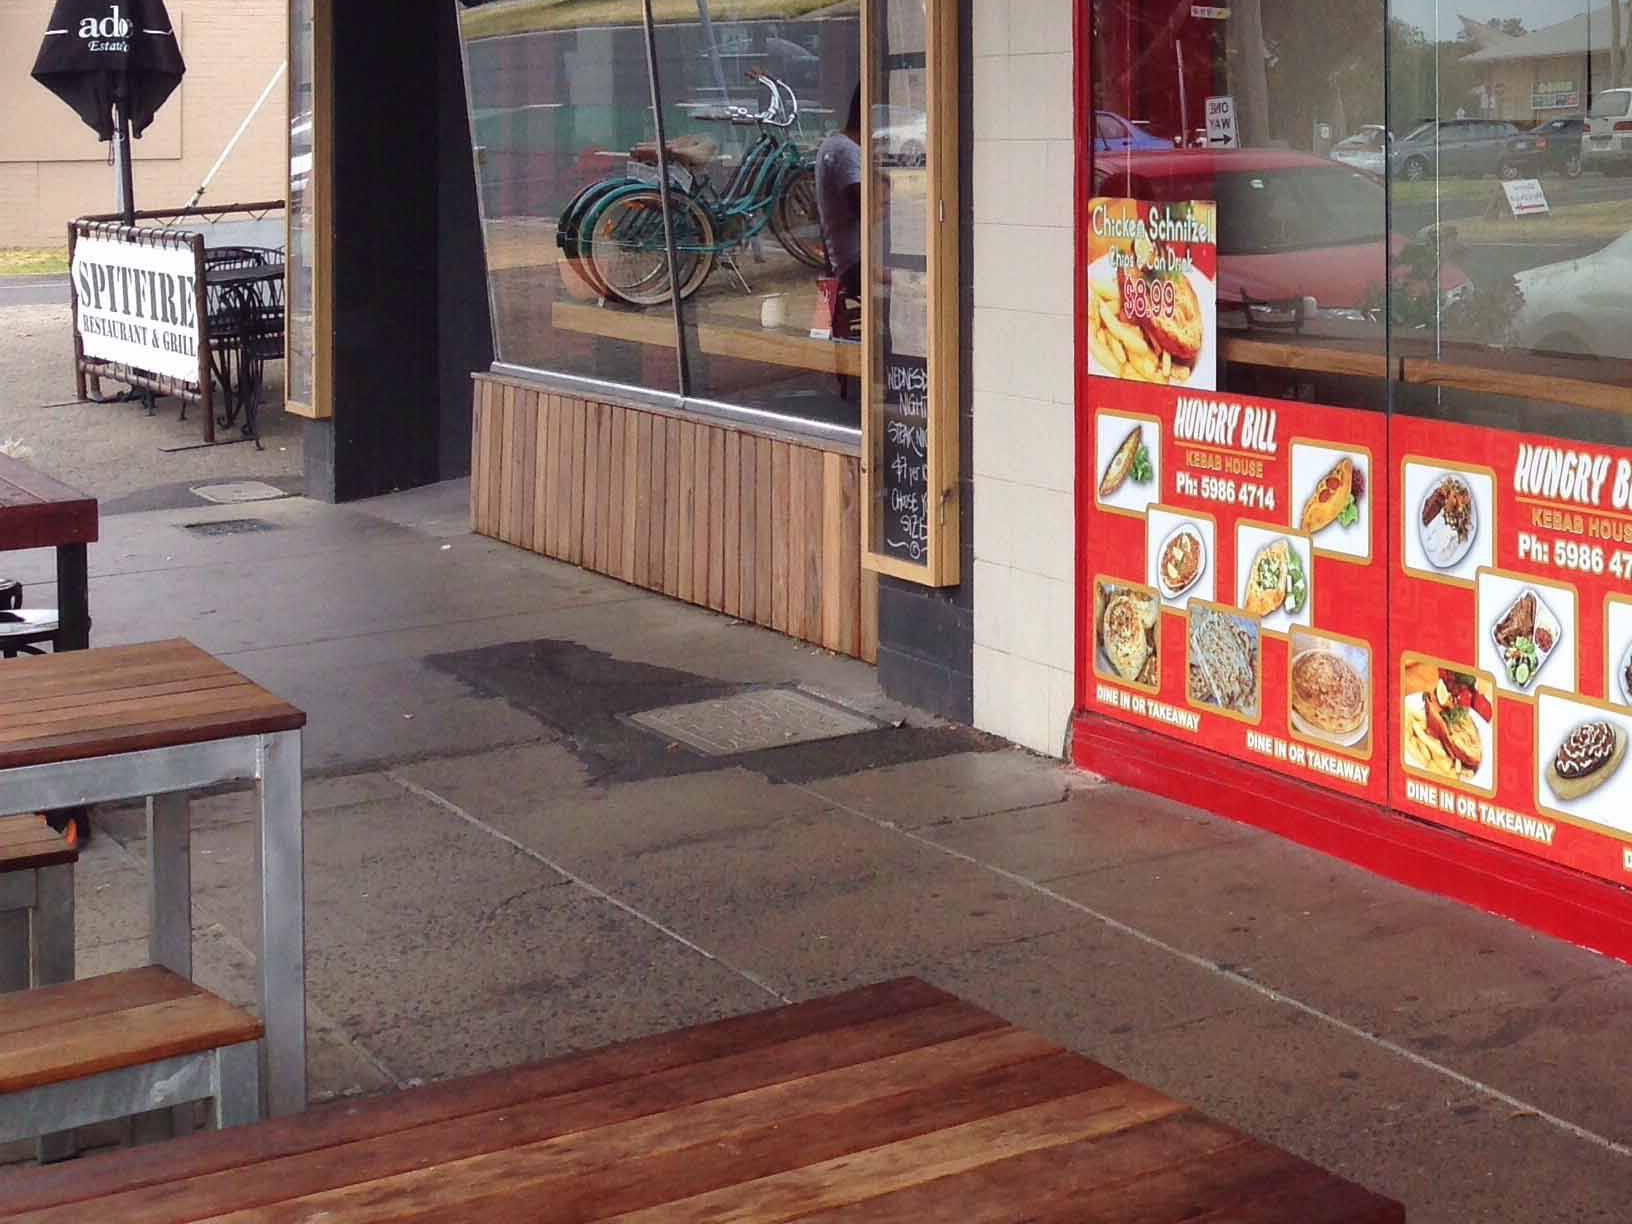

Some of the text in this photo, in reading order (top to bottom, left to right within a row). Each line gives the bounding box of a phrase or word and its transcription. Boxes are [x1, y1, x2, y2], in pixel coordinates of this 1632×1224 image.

[1092, 204, 1146, 238] Chicken
[79, 260, 195, 328] SPITFIRE
[1124, 276, 1175, 318] $8.99
[82, 313, 197, 358] RESTAURANT & GRILL
[1174, 396, 1278, 453] HUNGRY BILL
[1185, 448, 1264, 479] KEBAB HOUSE
[1513, 442, 1613, 506] HUNGRY
[1175, 470, 1276, 511] Ph: 5986 4714
[1531, 507, 1585, 535] KEBAB
[1518, 532, 1550, 564] Ph:
[1554, 539, 1605, 575] 5986
[1096, 684, 1201, 733] DINE IN OR TAKEAWAY
[1246, 730, 1371, 786] DINE IN OR TAKEAWAY
[1405, 780, 1557, 845] DINE IN OR TAKEAWAY
